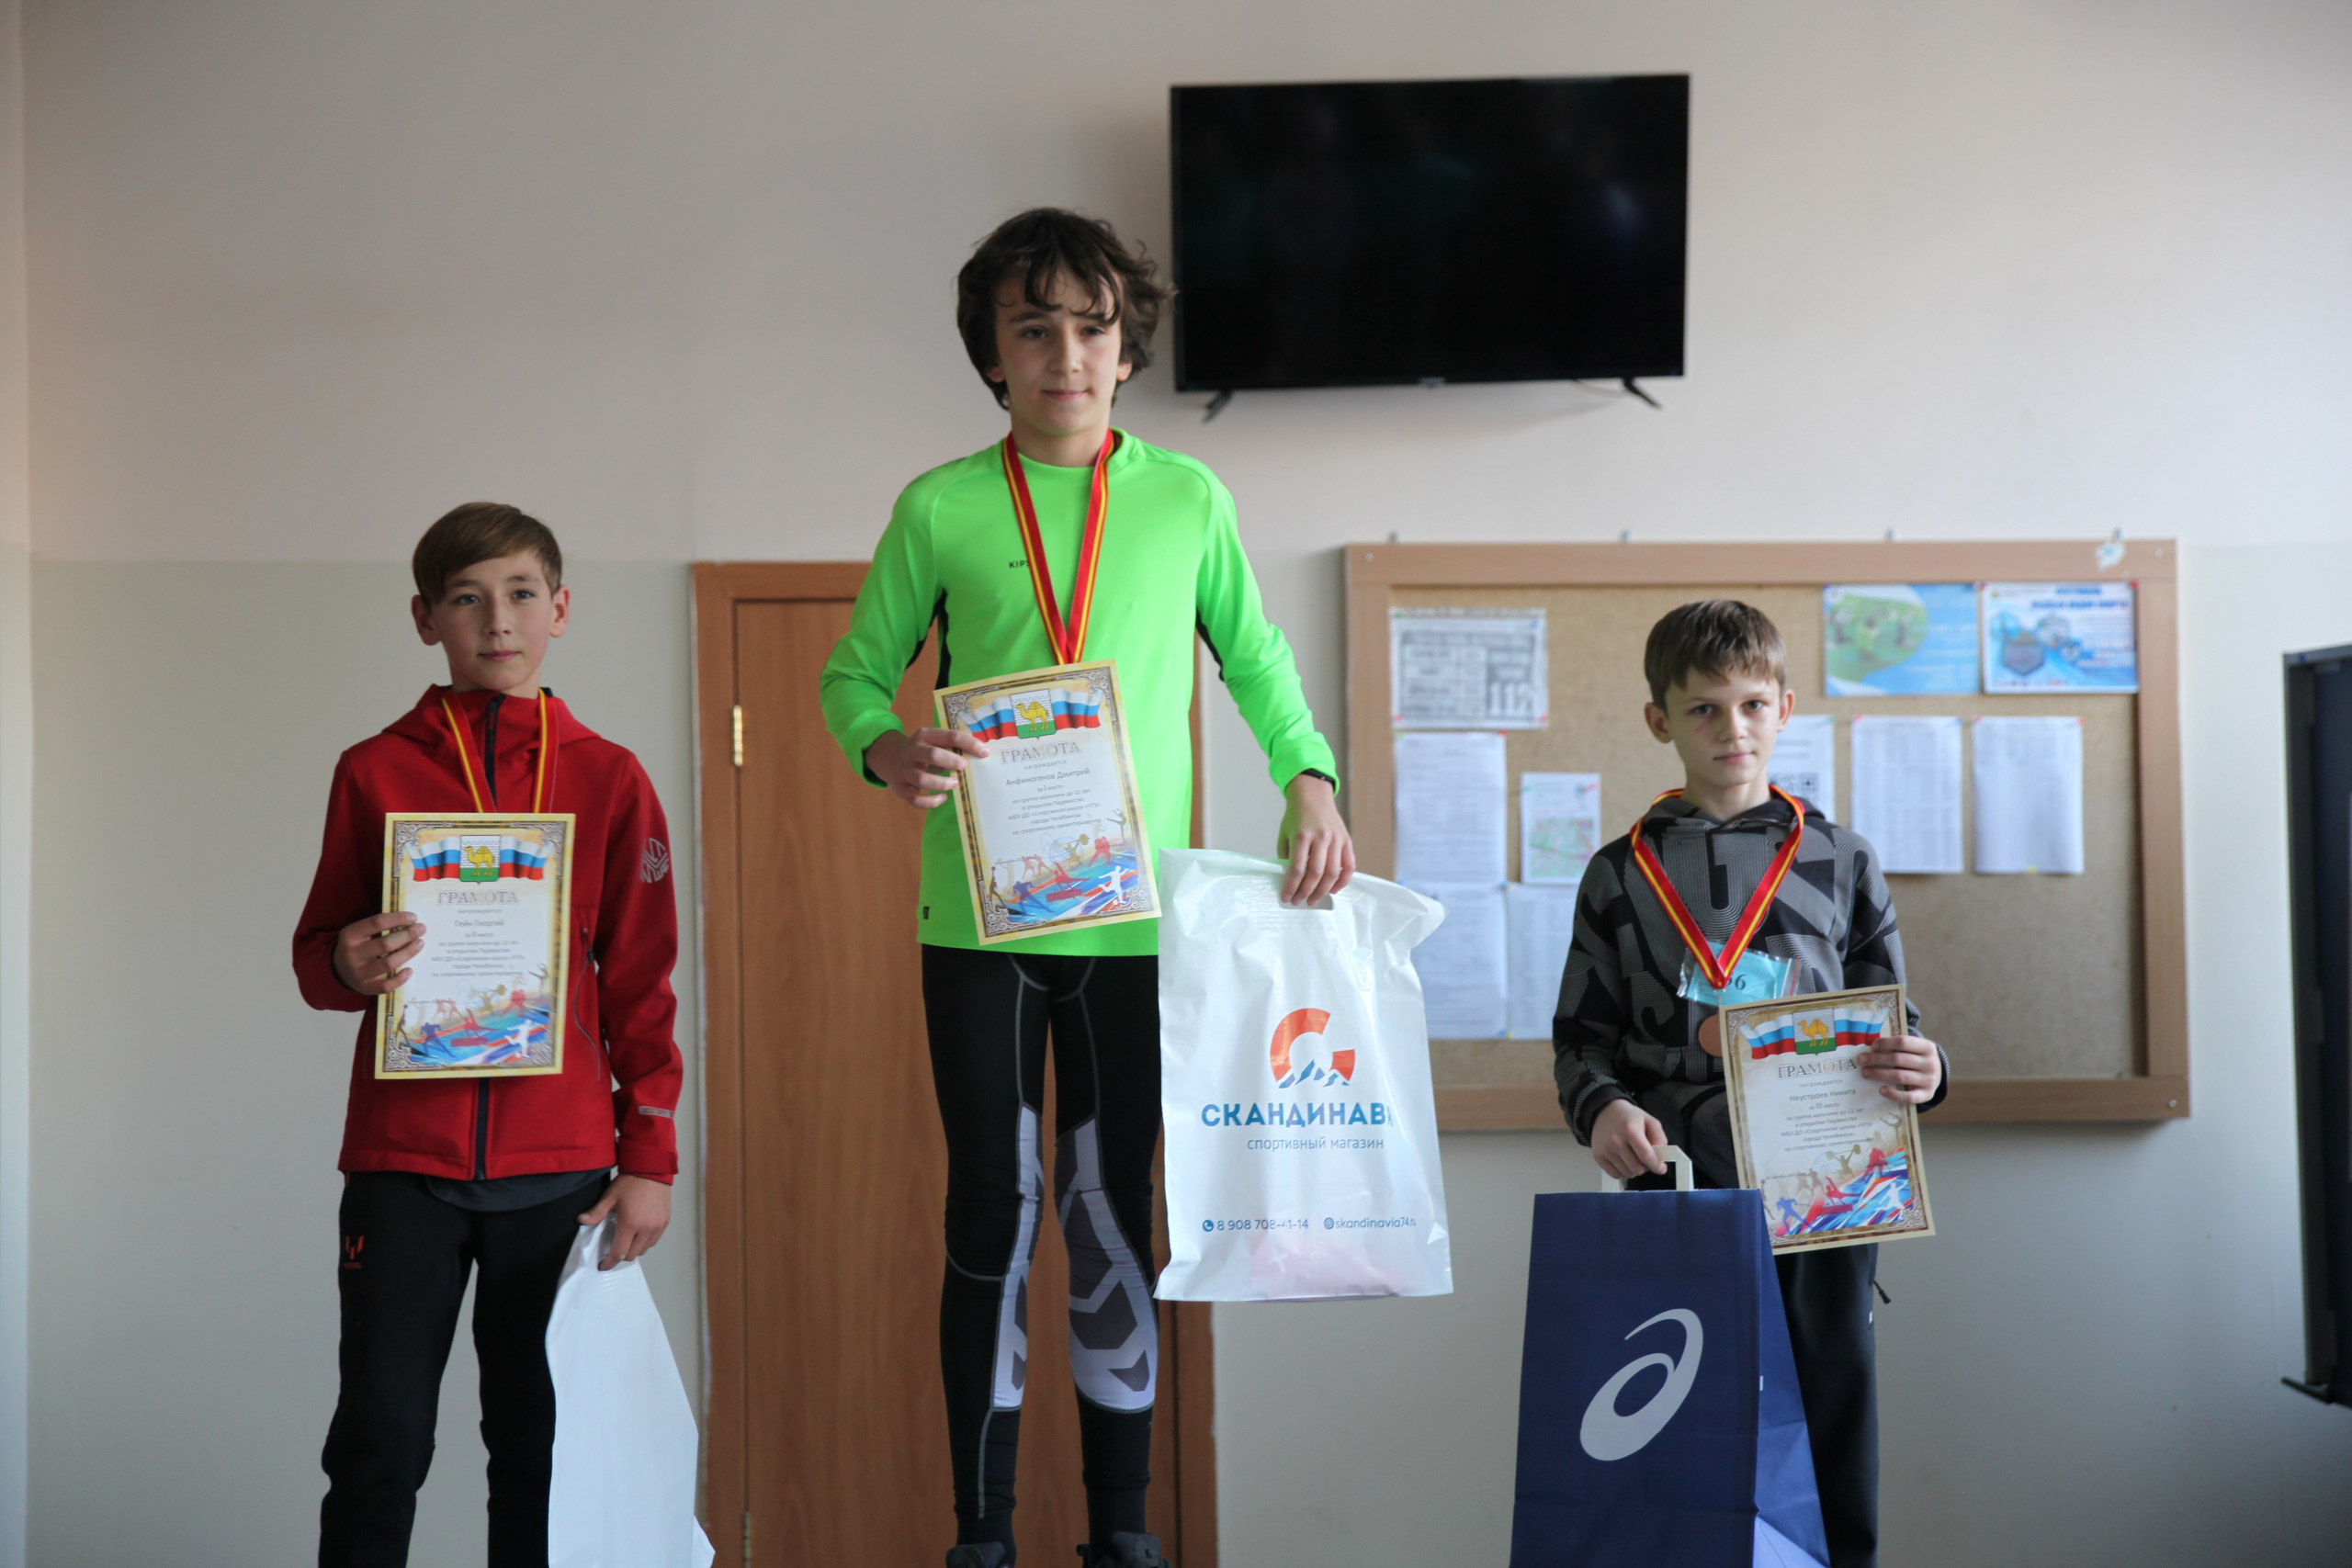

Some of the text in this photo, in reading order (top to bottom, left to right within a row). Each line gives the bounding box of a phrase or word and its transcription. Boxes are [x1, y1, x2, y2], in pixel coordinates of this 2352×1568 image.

[1490, 682, 1532, 716] 112
[1000, 741, 1080, 763] ГРАМОТА
[1023, 760, 1067, 770] награждается
[1006, 768, 1091, 785] Анфиногенов Дмитрий
[1053, 797, 1084, 806] Первенстве
[437, 891, 519, 904] ГРАМОТА
[1777, 1058, 1858, 1078] ГРАМОТА
[1799, 1078, 1843, 1088] награждается
[1789, 1089, 1856, 1101] Неустроев Никита
[1201, 1102, 1394, 1128] СКАНДИНАВ
[1247, 1136, 1384, 1153] спортивный магазин
[1216, 1220, 1225, 1231] 8
[1227, 1219, 1251, 1231] 908
